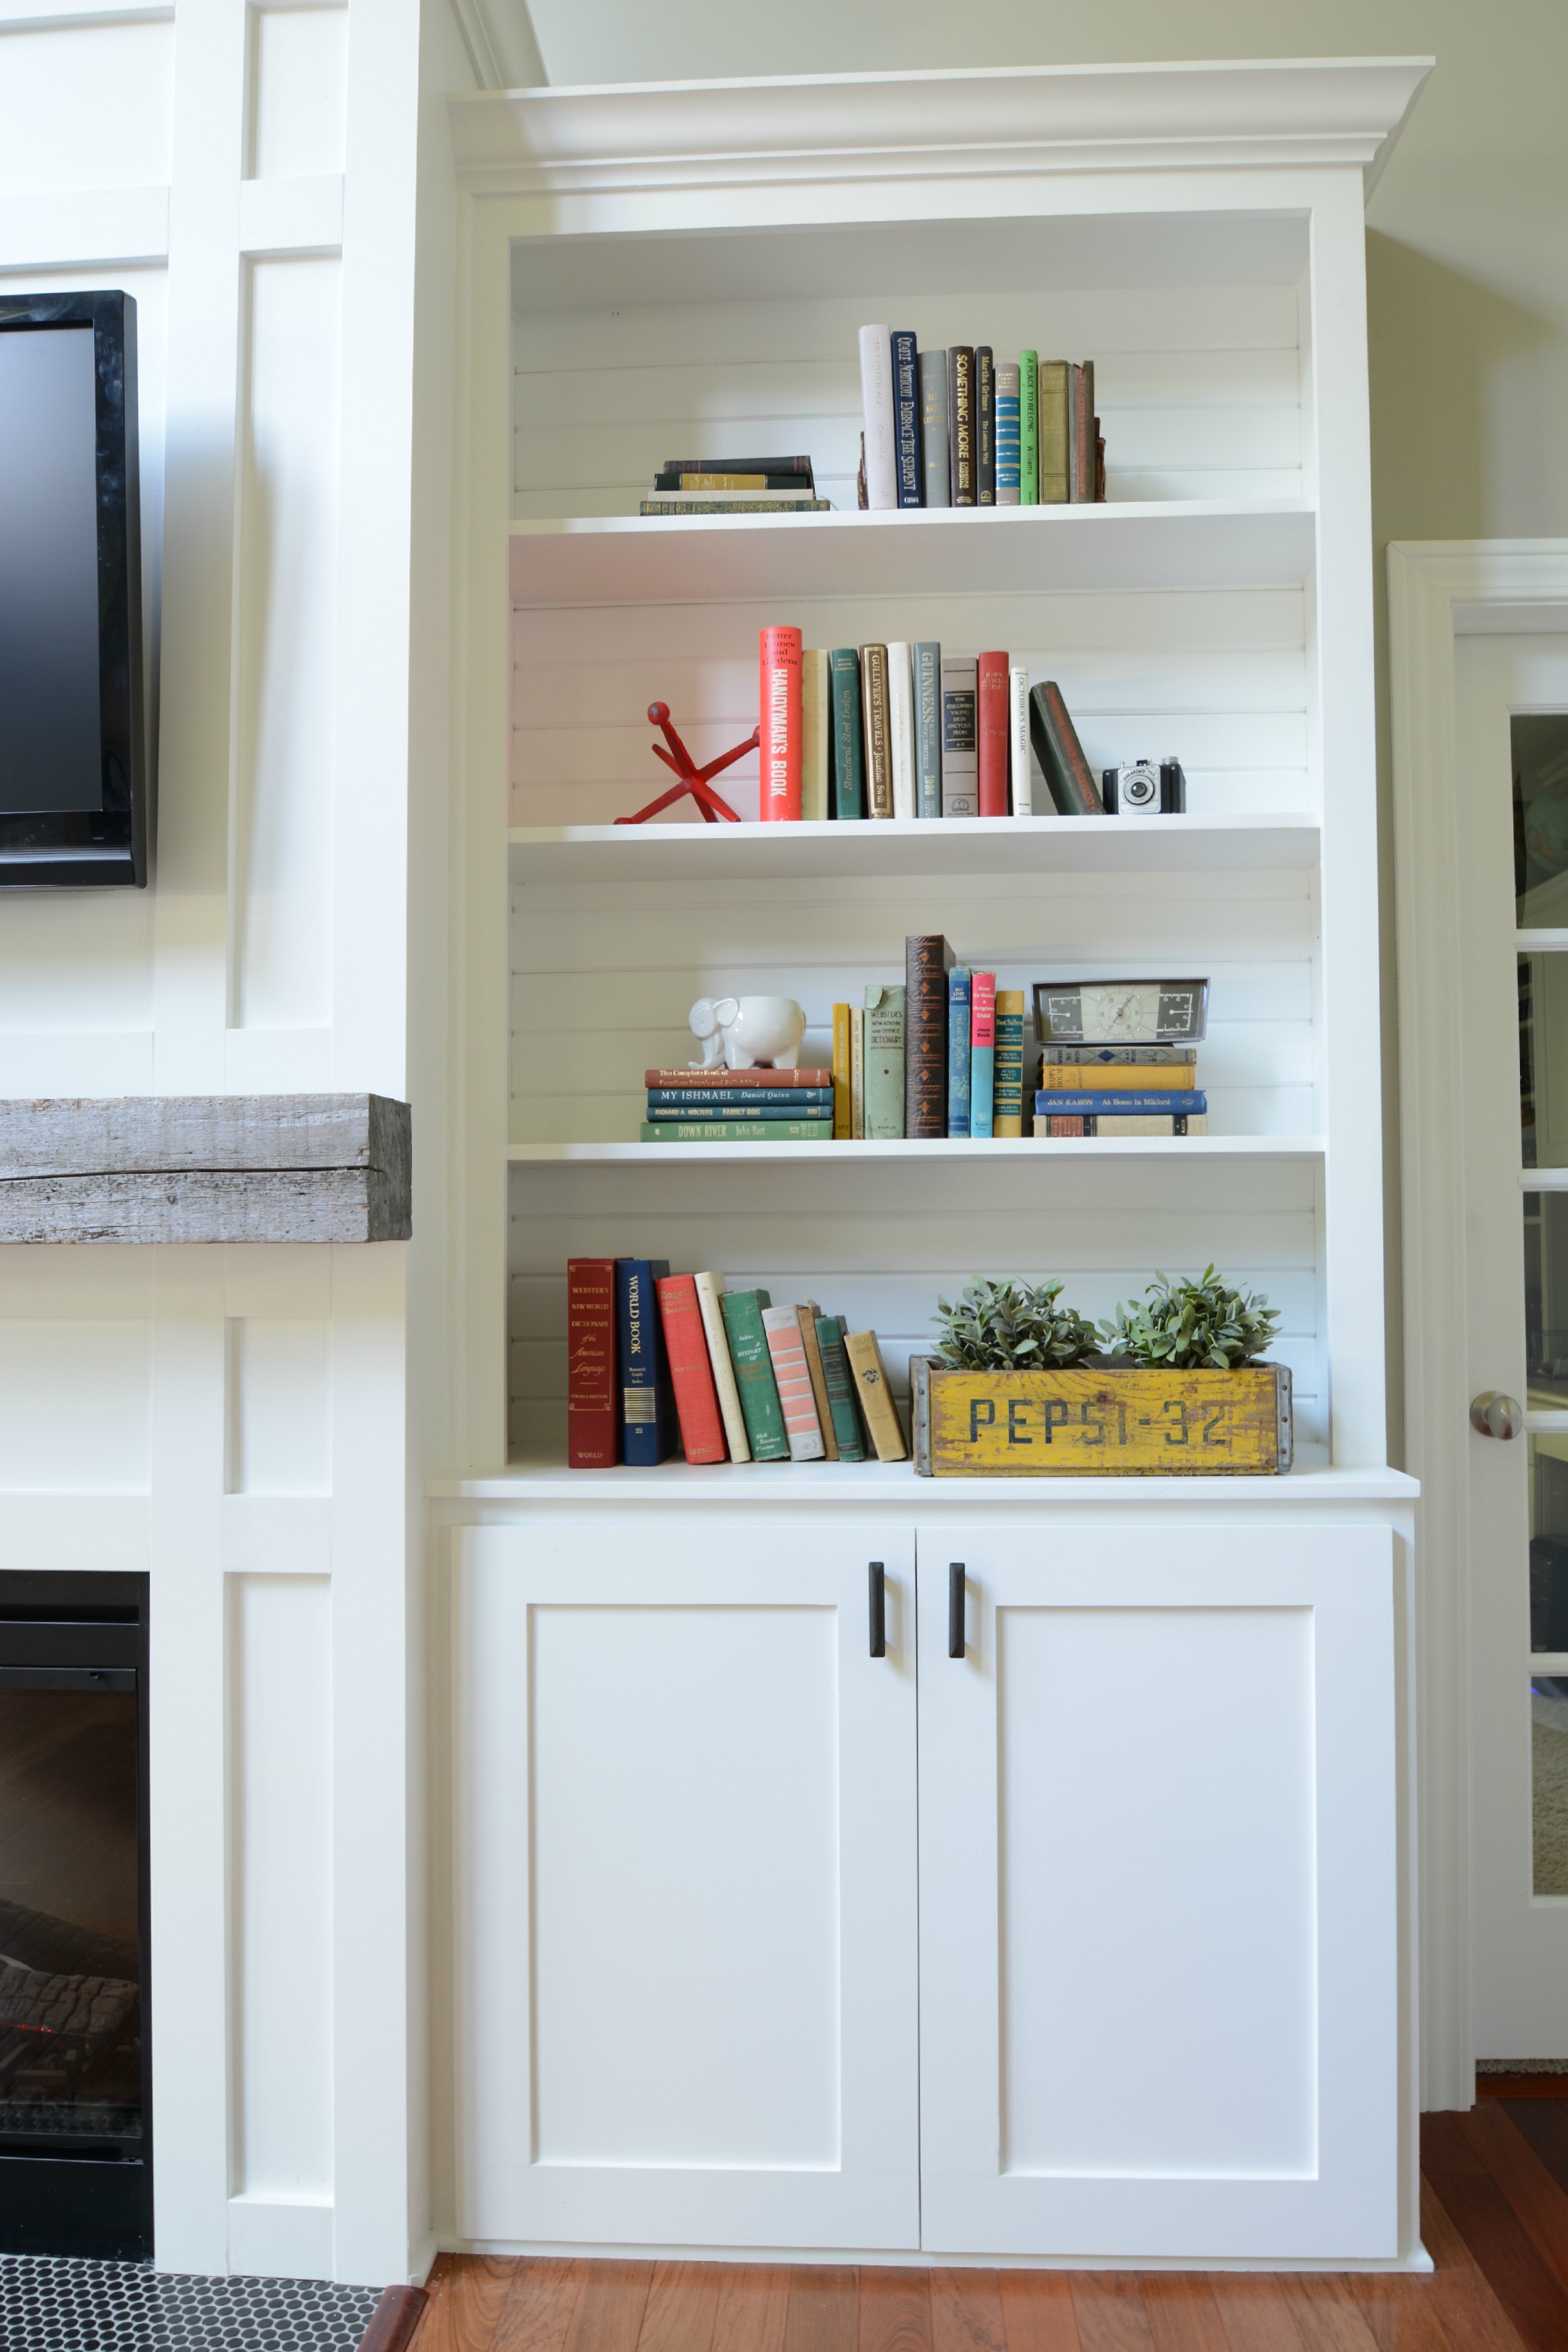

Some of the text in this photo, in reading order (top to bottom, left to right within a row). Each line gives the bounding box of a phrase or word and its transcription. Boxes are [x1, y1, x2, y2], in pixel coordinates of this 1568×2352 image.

[981, 355, 990, 411] Martha Grimes
[956, 354, 969, 458] SOMETHING MORE
[1027, 391, 1034, 402] TO
[900, 401, 915, 437] EMBRACE
[901, 438, 915, 455] THE
[901, 456, 917, 490] SERPENT
[922, 651, 935, 723] GUINNESS
[872, 655, 884, 746] GULLIVER'S TRAVELS
[770, 669, 788, 798] HANDYMAN'S BOOK
[841, 690, 853, 790] Structural Steel Design
[874, 751, 885, 803] Jonathan Swift
[661, 1091, 734, 1100] MY ISHMAEL
[678, 1125, 727, 1138] DOWN RIVER
[736, 1125, 765, 1137] John Hart
[661, 1289, 694, 1300] Roget's
[629, 1275, 641, 1354] WORLD BOOK
[663, 1305, 698, 1315] Thesaurus
[704, 1294, 717, 1332] HANDBOOK
[580, 1333, 589, 1344] of
[856, 1345, 872, 1355] RIED
[569, 1347, 605, 1358] American
[737, 1348, 762, 1358] HISTORY
[571, 1362, 606, 1376] Language
[970, 1398, 1226, 1445] PEPSI-32
